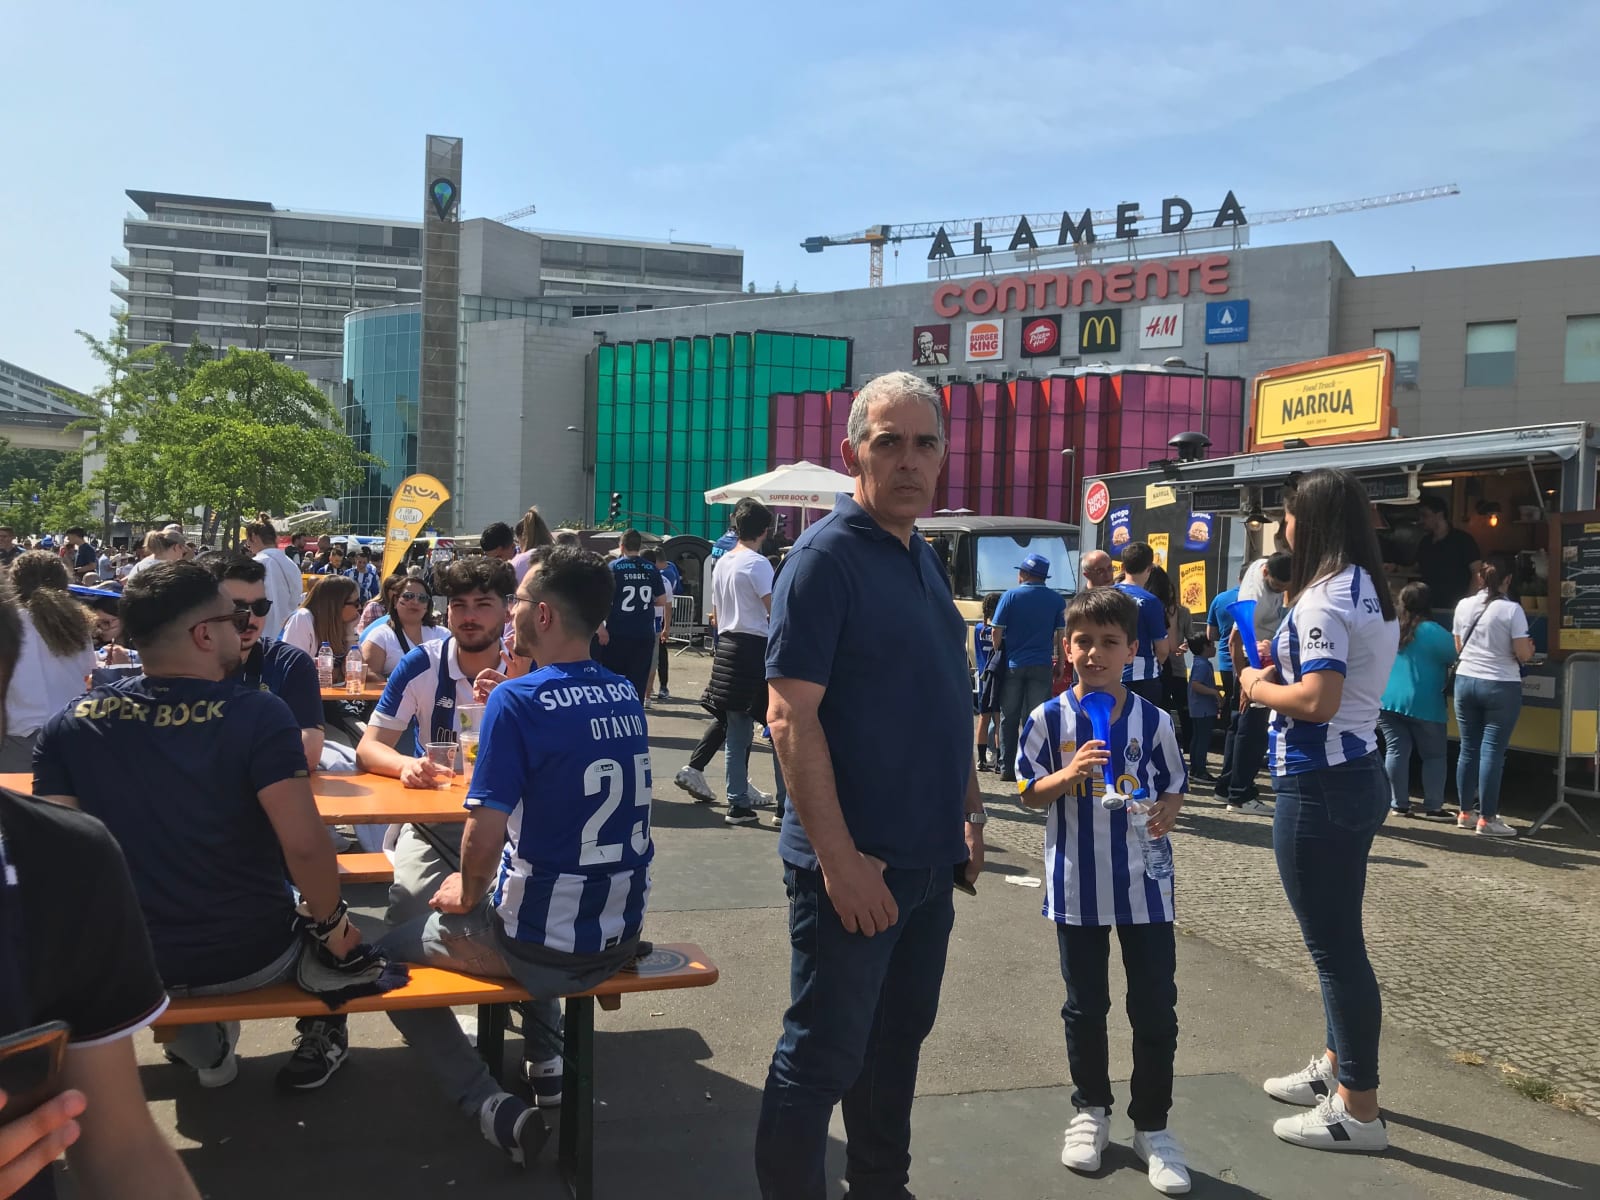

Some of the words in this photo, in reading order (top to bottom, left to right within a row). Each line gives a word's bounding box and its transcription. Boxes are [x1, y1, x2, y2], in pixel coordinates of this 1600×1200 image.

[927, 190, 1247, 260] ALAMEDA
[933, 255, 1229, 317] CONTINENTE
[969, 333, 999, 341] BURGER
[1145, 315, 1177, 337] H&M
[969, 342, 998, 352] KING
[1281, 388, 1354, 425] NARRUA
[1087, 488, 1107, 506] SUPER
[1089, 499, 1107, 515] BOCK
[1110, 509, 1129, 522] Prego
[1180, 564, 1205, 578] Batatas
[621, 585, 652, 612] 29
[1305, 641, 1335, 650] OCHE
[539, 685, 608, 711] SUPER
[606, 682, 641, 702] BOC
[74, 696, 150, 722] SUPER
[153, 700, 227, 727] BOCK
[579, 752, 652, 866] 25
